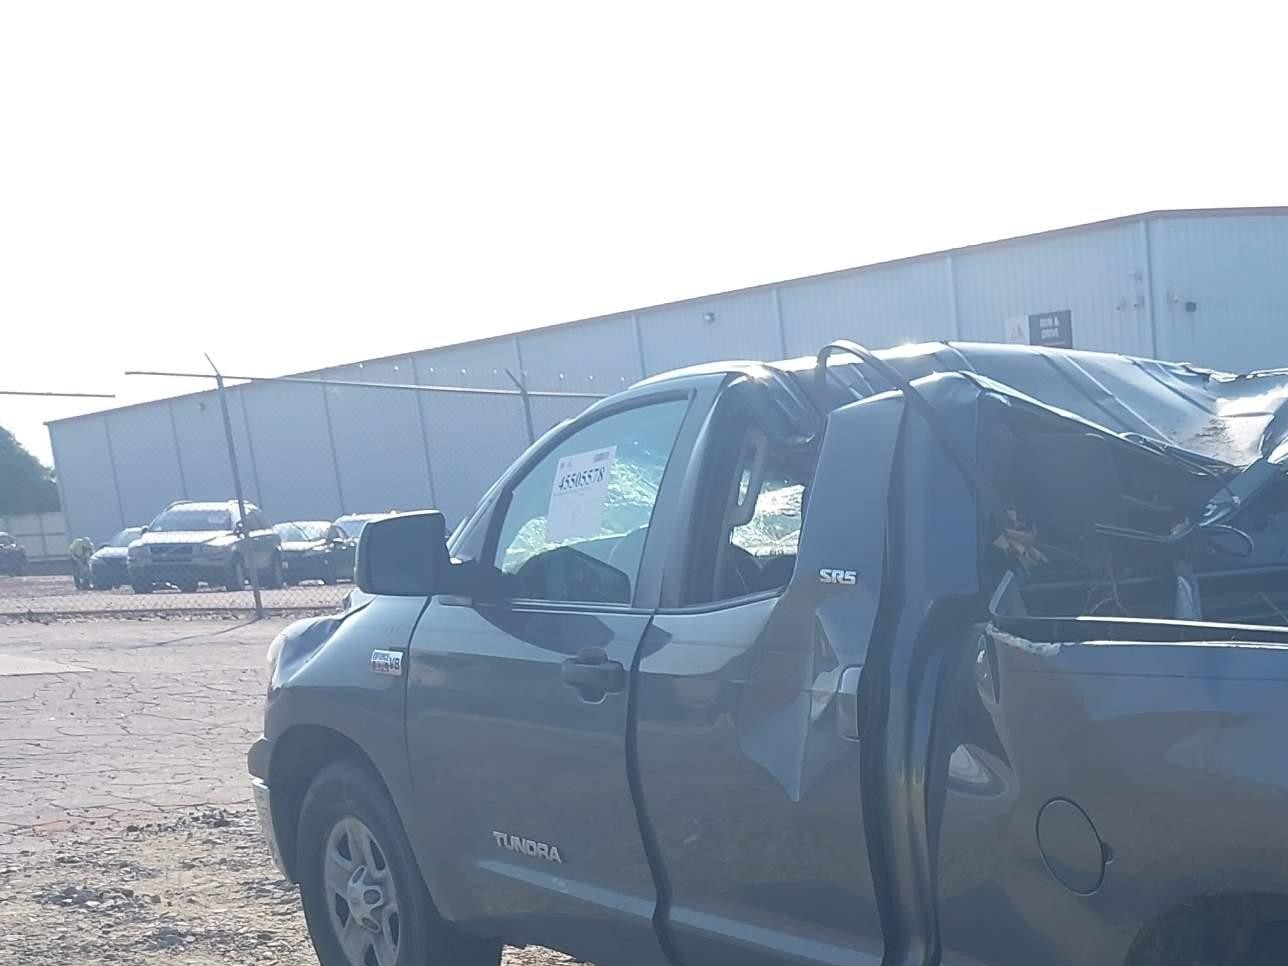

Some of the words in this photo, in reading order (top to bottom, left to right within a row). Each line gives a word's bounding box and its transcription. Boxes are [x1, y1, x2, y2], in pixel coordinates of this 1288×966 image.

[558, 466, 606, 490] 45505578
[819, 568, 857, 585] SR5
[491, 830, 563, 863] TUNDRA
